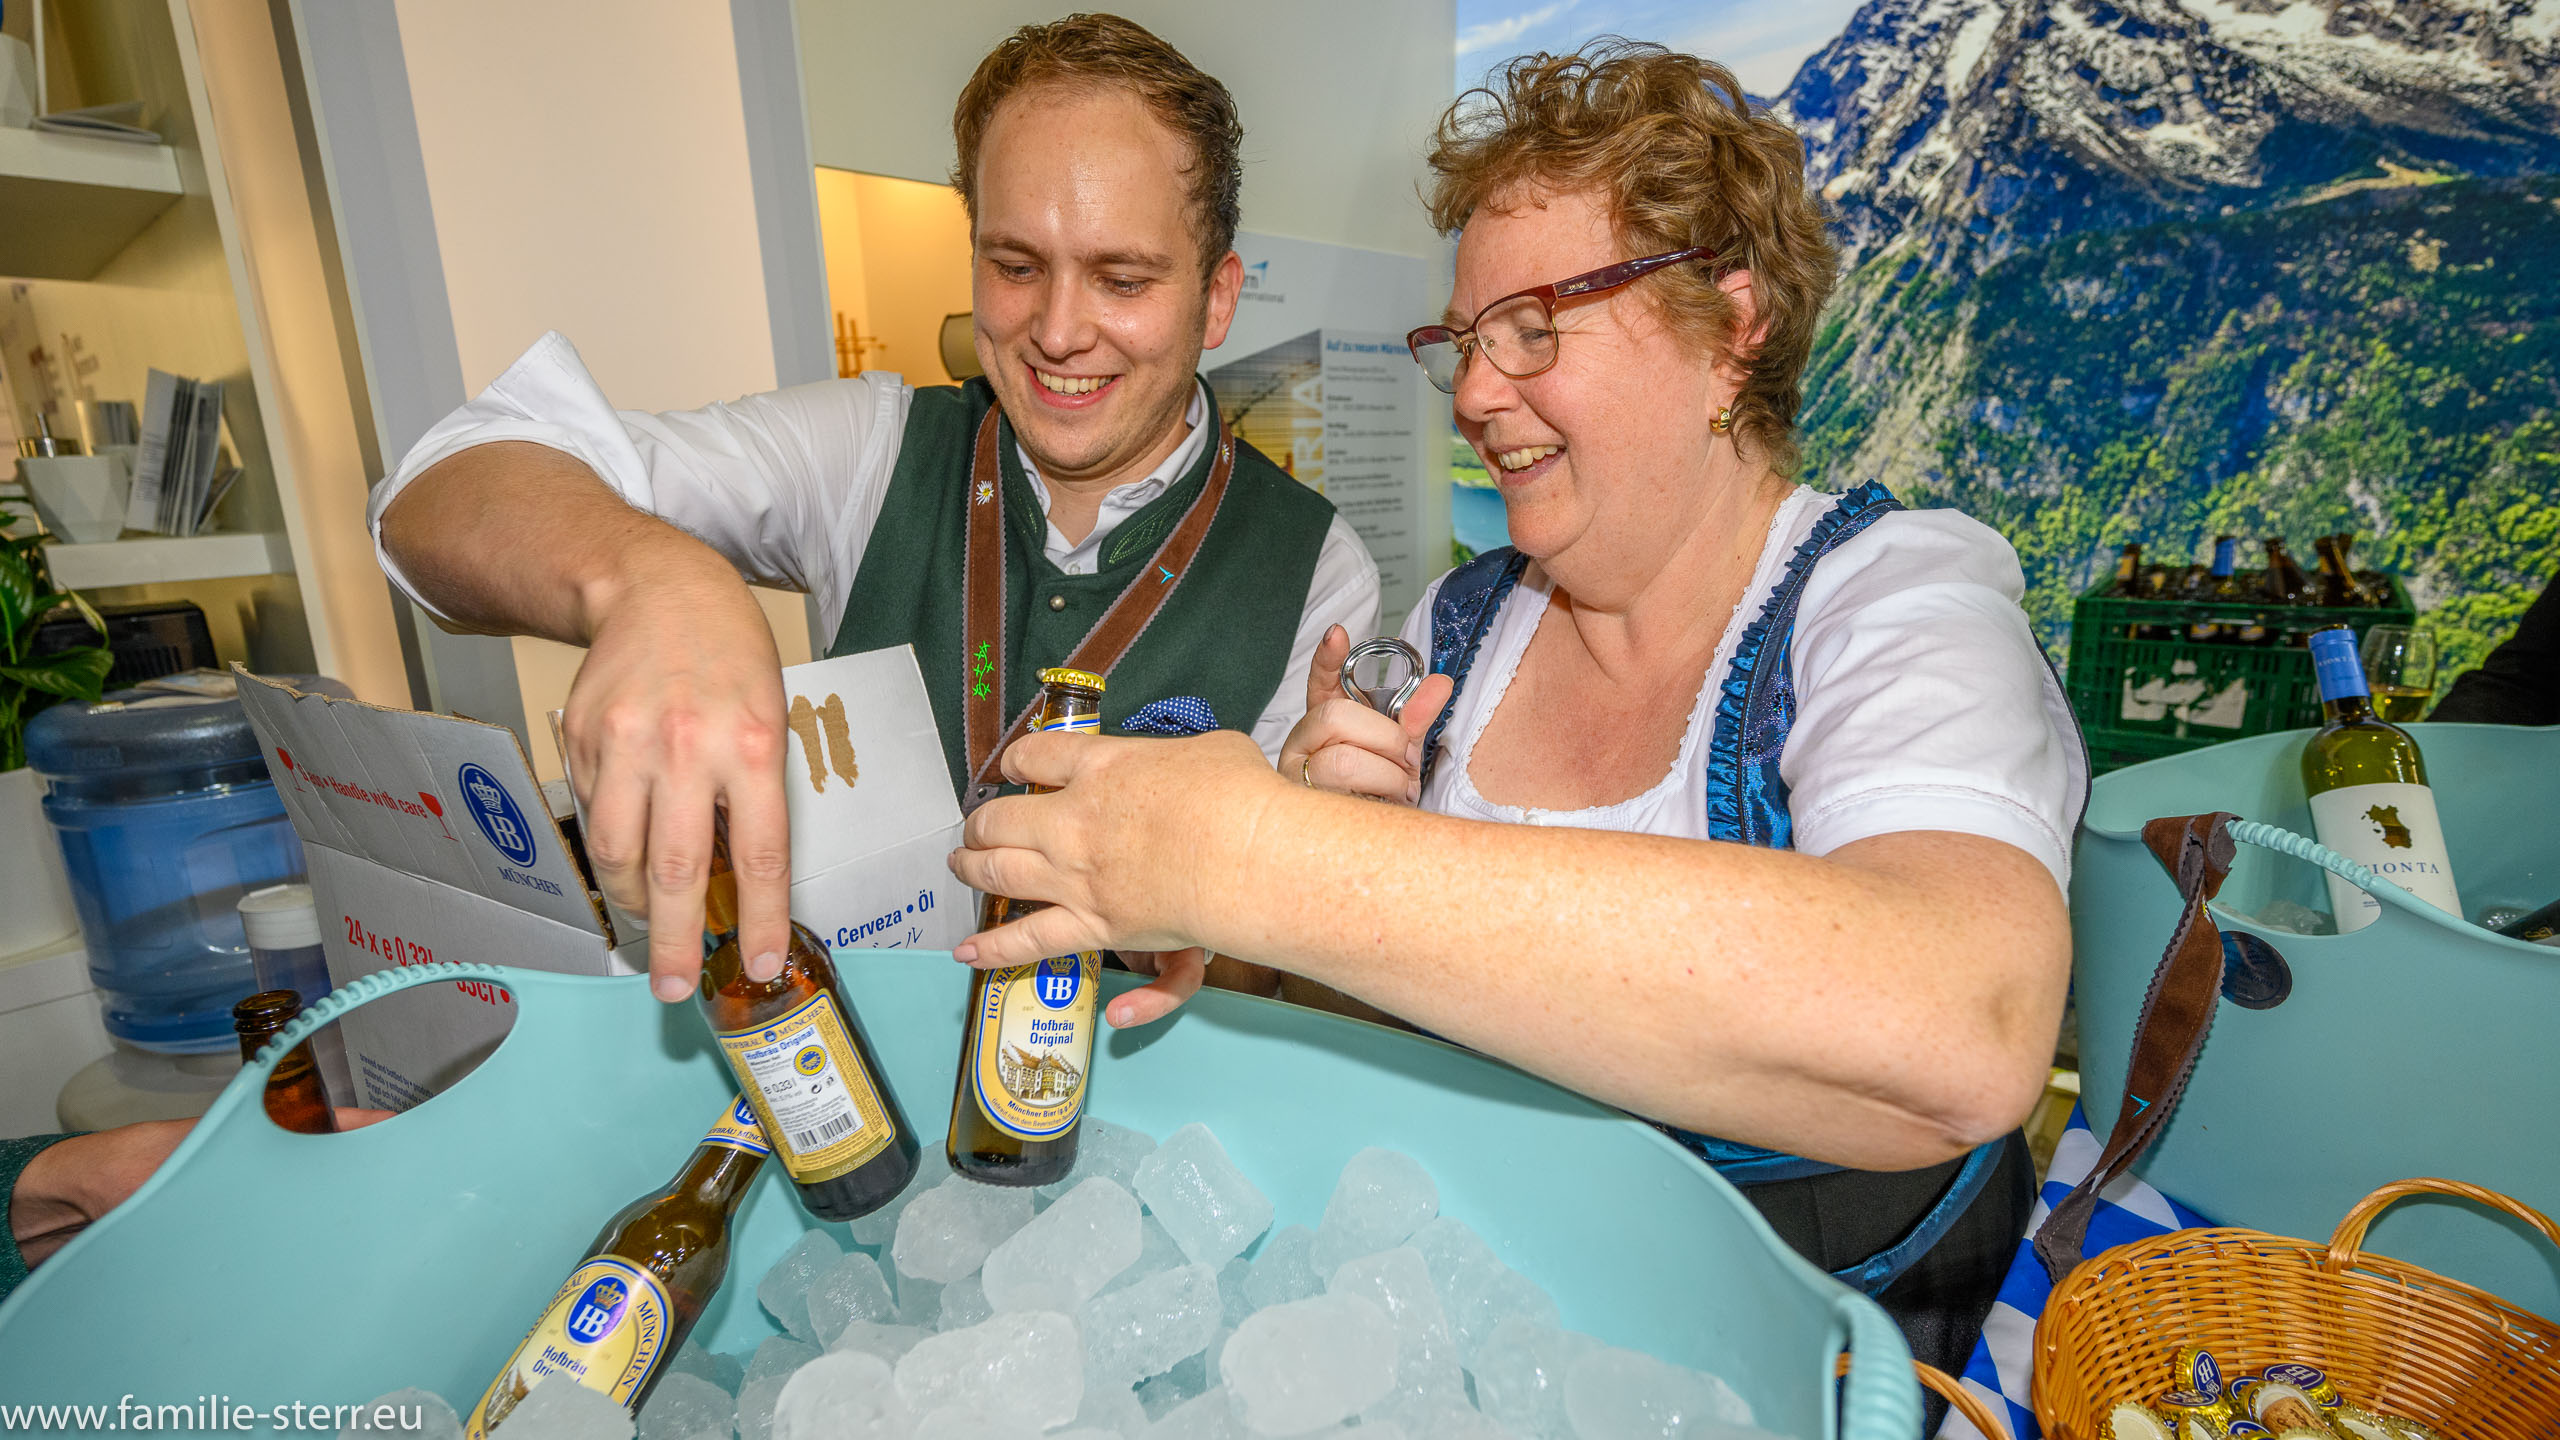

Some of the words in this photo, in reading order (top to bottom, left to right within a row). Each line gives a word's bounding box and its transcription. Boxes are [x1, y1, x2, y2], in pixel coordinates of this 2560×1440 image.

[327, 775, 371, 803] Handle
[368, 788, 399, 811] with
[398, 799, 428, 819] care
[497, 866, 564, 897] MÜNCHEN
[345, 915, 366, 950] 24
[366, 930, 380, 956] x
[837, 909, 903, 948] Cerveza
[918, 889, 935, 913] Öl
[1043, 976, 1074, 1001] HB
[777, 1002, 827, 1037] MÜNCHEN
[1031, 1018, 1075, 1032] Hofbräu
[744, 1044, 780, 1061] Hofbräu
[779, 1026, 816, 1051] Original
[1030, 1031, 1074, 1048] Original
[1007, 1099, 1042, 1118] Münchner
[1043, 1109, 1057, 1118] Bier
[571, 1303, 611, 1338] HB
[542, 1344, 589, 1376] Hofbräu
[622, 1300, 658, 1389] MÜNCHEN
